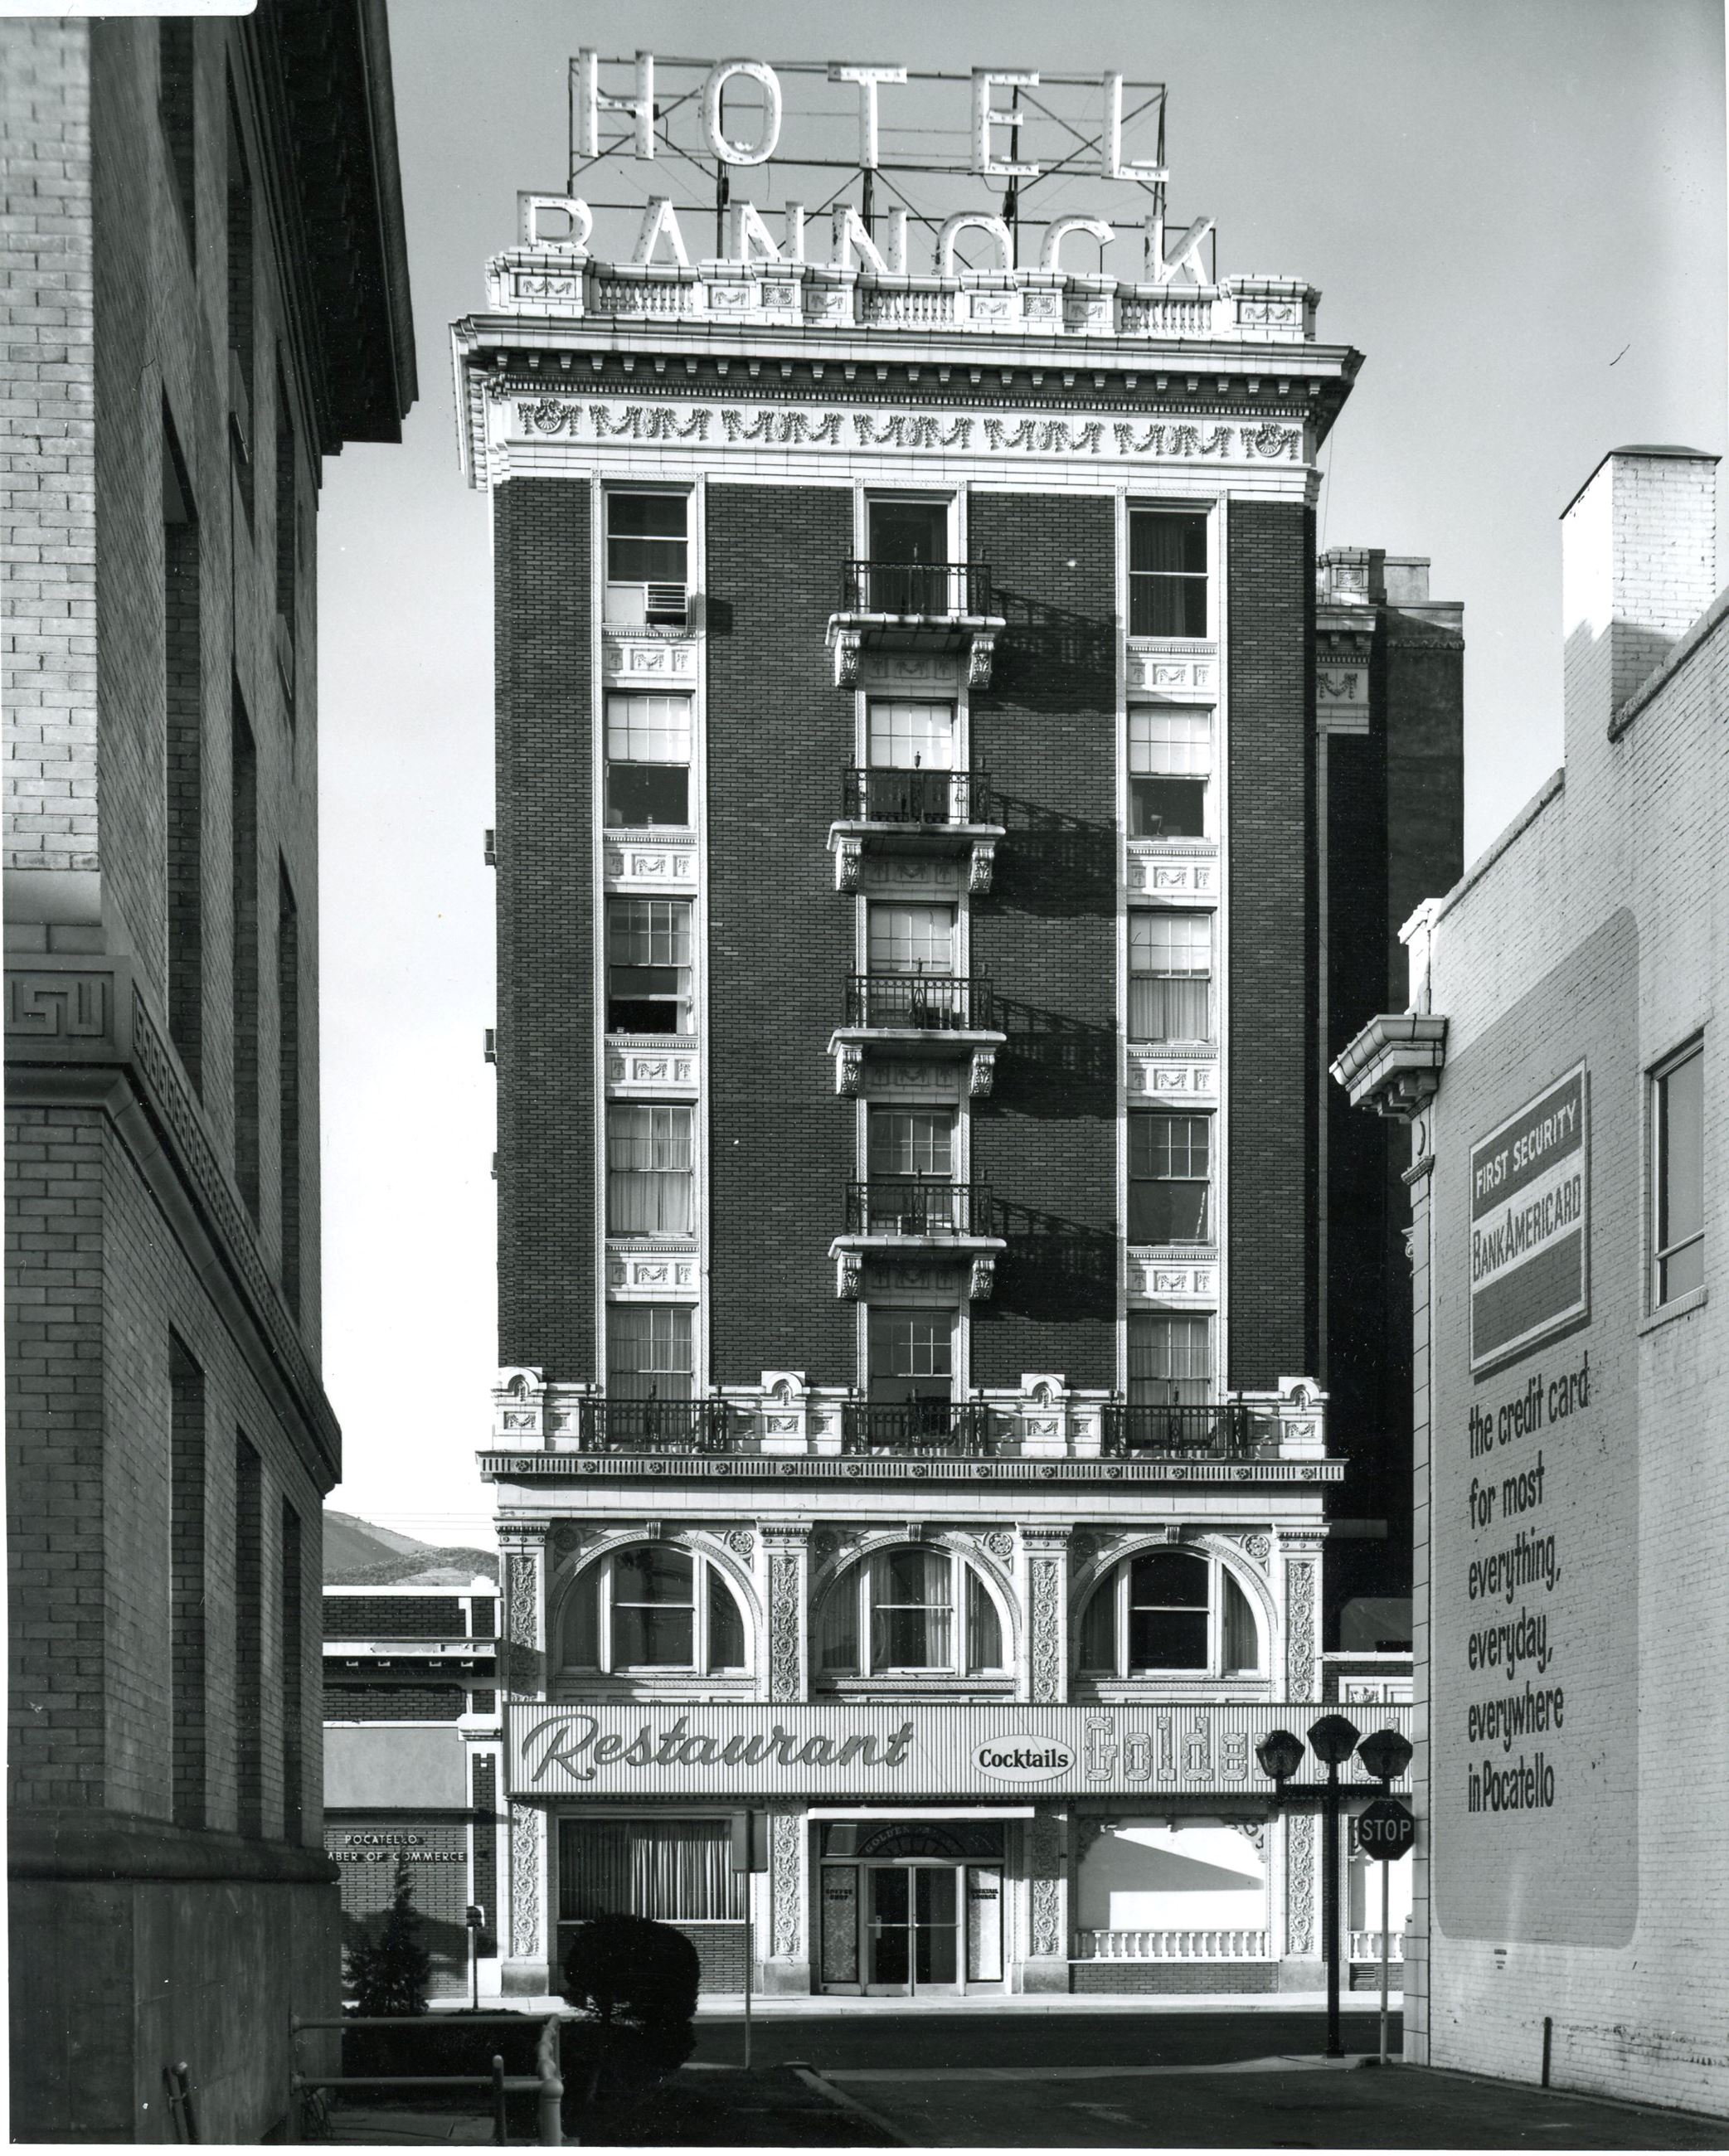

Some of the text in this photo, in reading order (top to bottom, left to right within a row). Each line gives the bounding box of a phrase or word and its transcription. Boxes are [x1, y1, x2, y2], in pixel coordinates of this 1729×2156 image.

[578, 46, 1169, 182] HOTEL
[517, 190, 1219, 285] BANNOCK
[1476, 1098, 1577, 1199] FIRST SECURITY
[1469, 1350, 1590, 1459] the credit card
[1469, 1449, 1546, 1530] for most
[1468, 1527, 1561, 1605] everything,
[1468, 1606, 1554, 1681] everyday,
[522, 1713, 915, 1782] Restaurant
[1468, 1680, 1564, 1753] everywhere
[978, 1747, 1069, 1770] Cocktails
[1468, 1751, 1555, 1814] in Pocatello
[345, 1834, 417, 1844] POCATELLO
[366, 1852, 383, 1861] OF
[392, 1851, 464, 1862] COMMERCE
[1361, 1819, 1411, 1841] STOP
